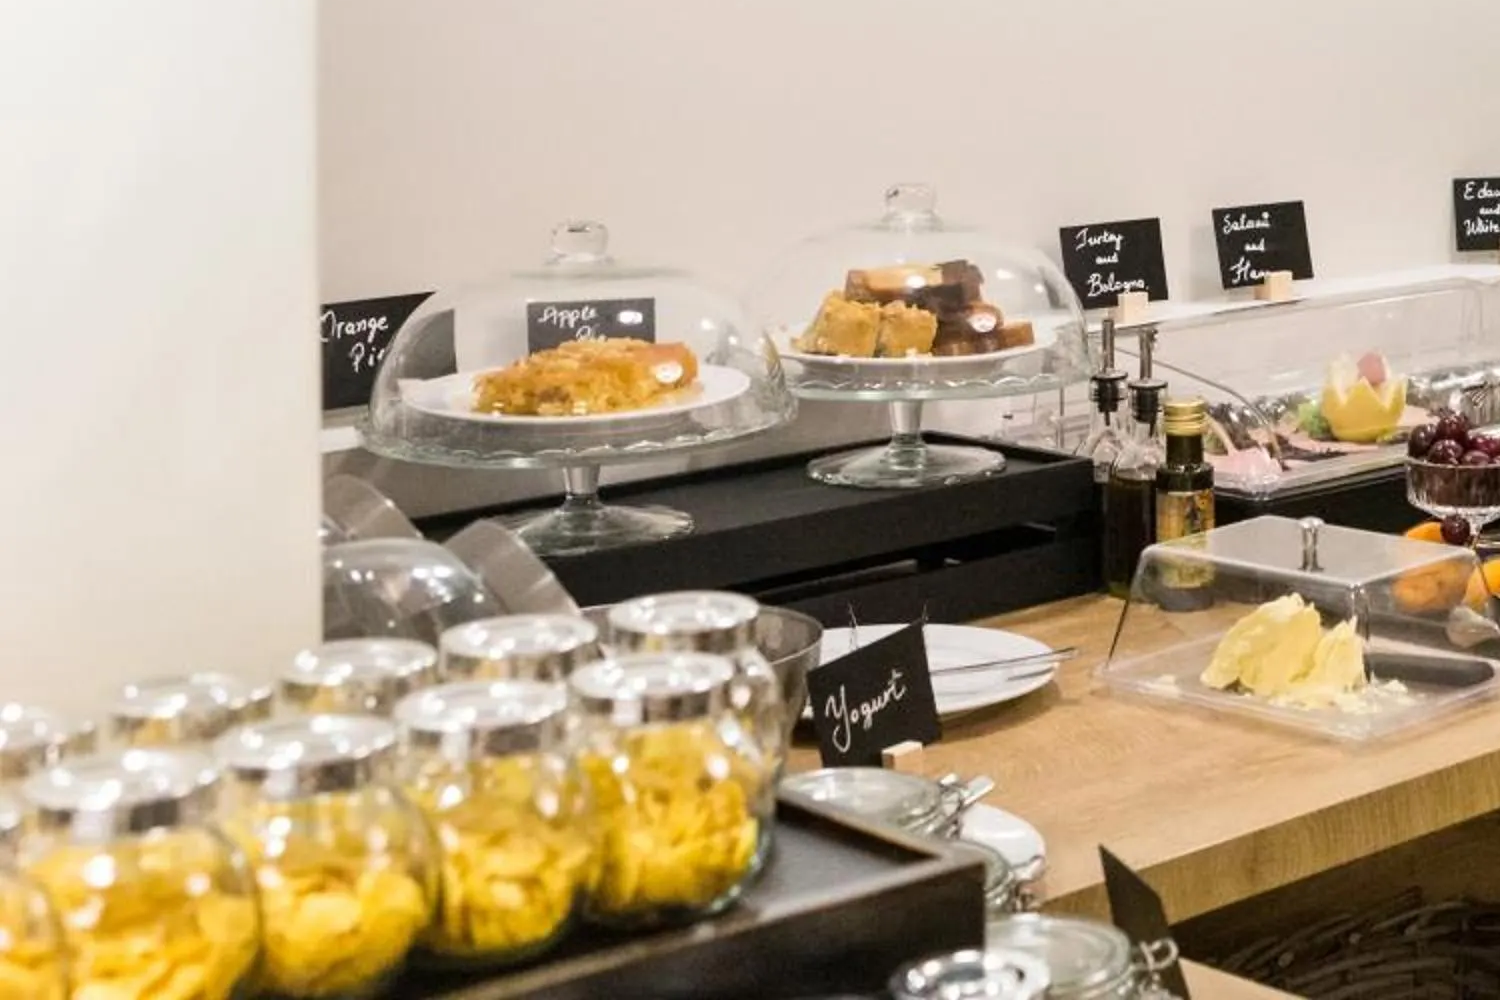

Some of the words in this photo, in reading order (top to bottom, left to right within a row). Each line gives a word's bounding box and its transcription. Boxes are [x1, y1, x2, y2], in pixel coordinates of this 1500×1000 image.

[1479, 203, 1500, 215] and
[1223, 212, 1271, 235] Salami
[1463, 216, 1500, 236] White
[1075, 227, 1124, 251] Turkey
[1244, 237, 1265, 252] and
[320, 310, 389, 343] Orange
[825, 668, 906, 752] Yogurt
